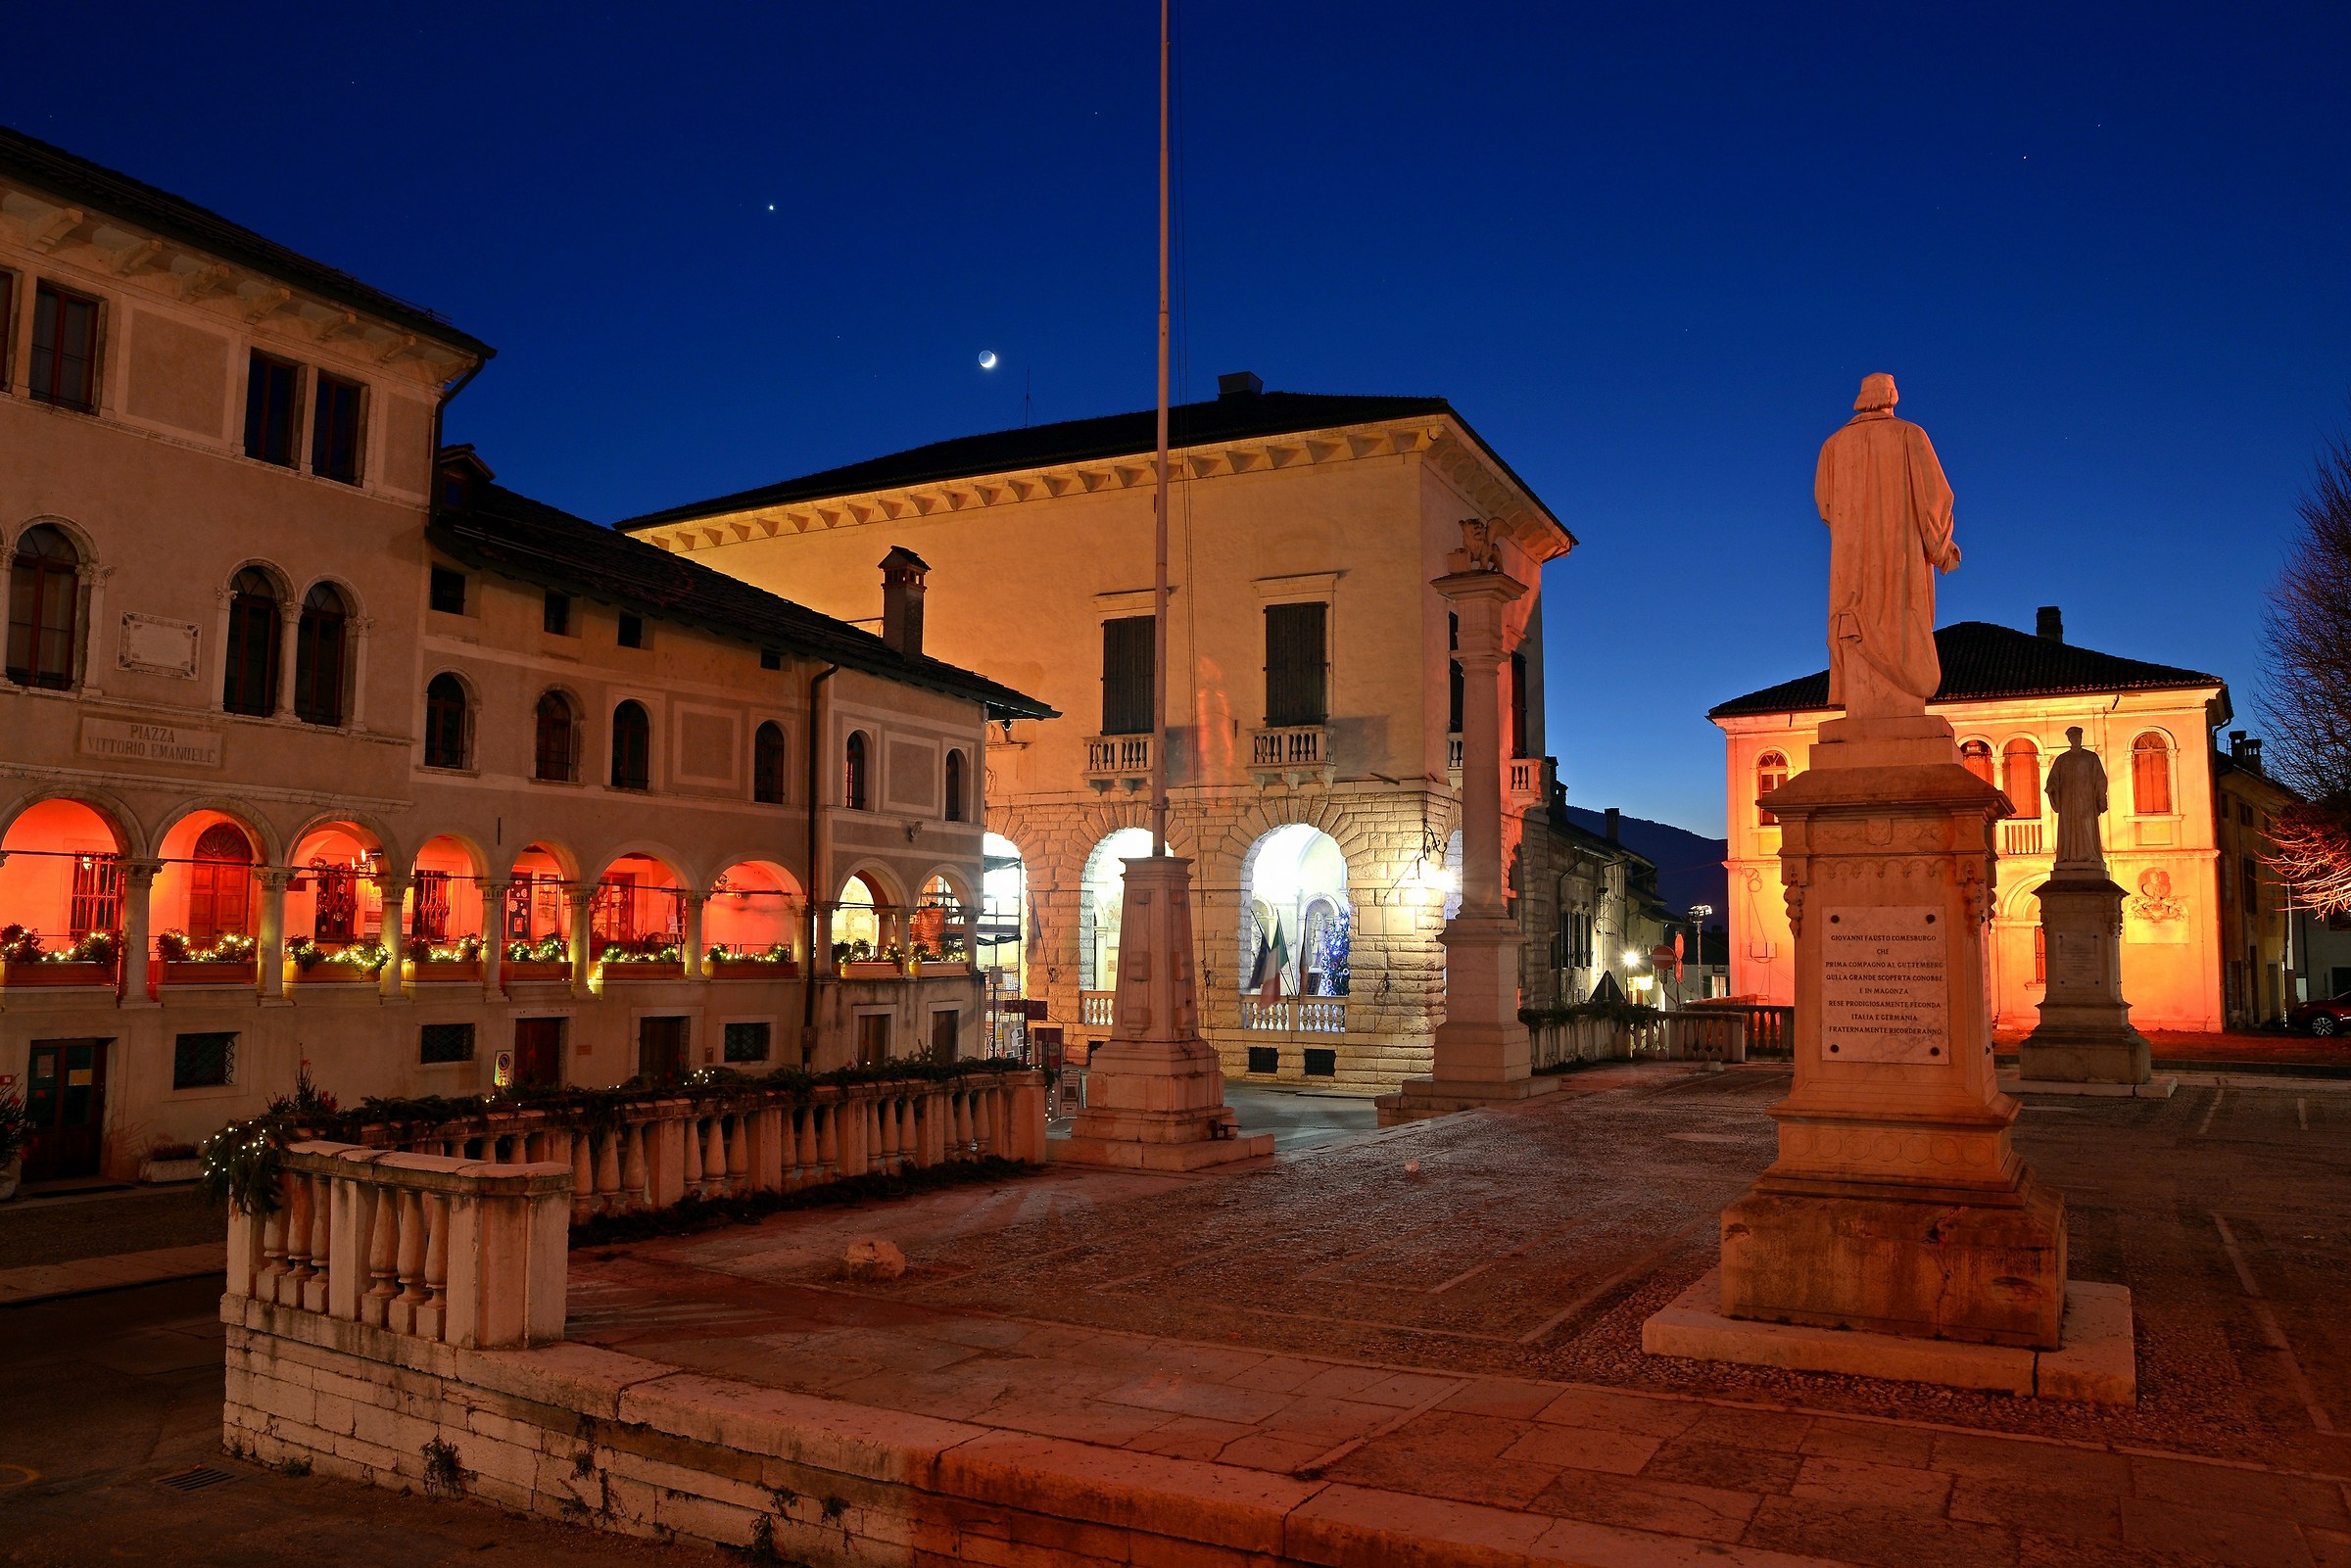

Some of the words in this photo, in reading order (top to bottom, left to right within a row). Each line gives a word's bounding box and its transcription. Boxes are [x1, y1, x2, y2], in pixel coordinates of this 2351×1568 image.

[131, 725, 175, 742] PIAZZA
[88, 737, 145, 756] VITTORIO
[152, 744, 215, 763] EMANUELE
